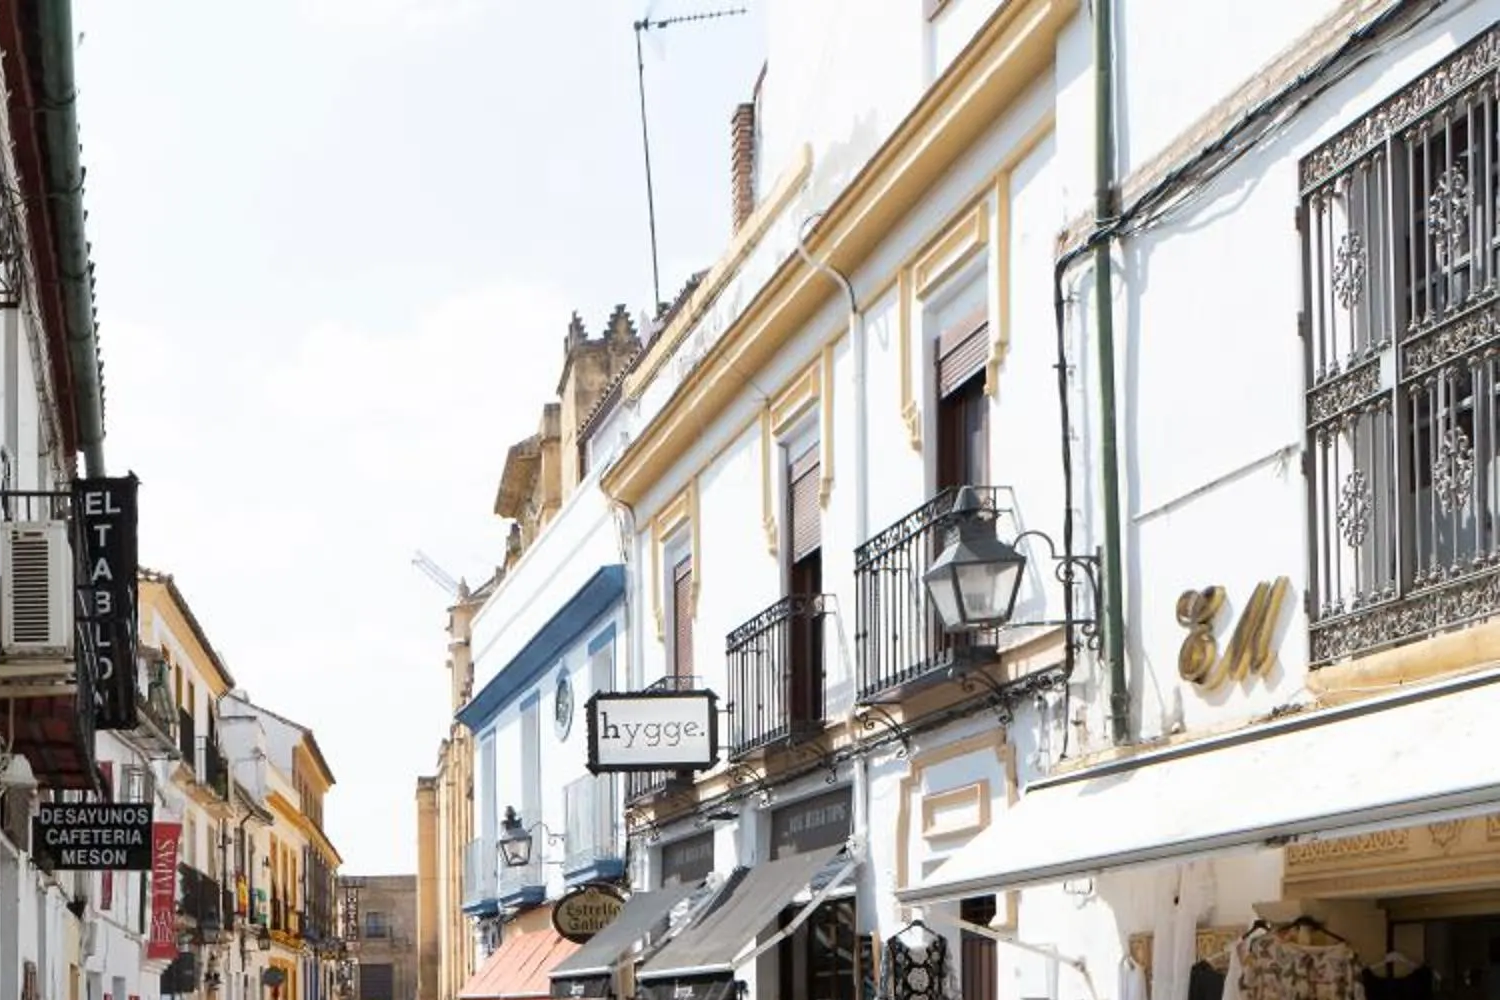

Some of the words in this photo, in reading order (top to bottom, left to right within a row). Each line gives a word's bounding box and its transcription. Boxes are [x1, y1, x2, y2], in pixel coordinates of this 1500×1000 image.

[85, 491, 121, 515] EL
[41, 808, 149, 825] DESAYUNOS
[46, 829, 143, 845] CAFETERIA
[61, 849, 127, 865] MESON
[155, 839, 174, 895] TAPAS
